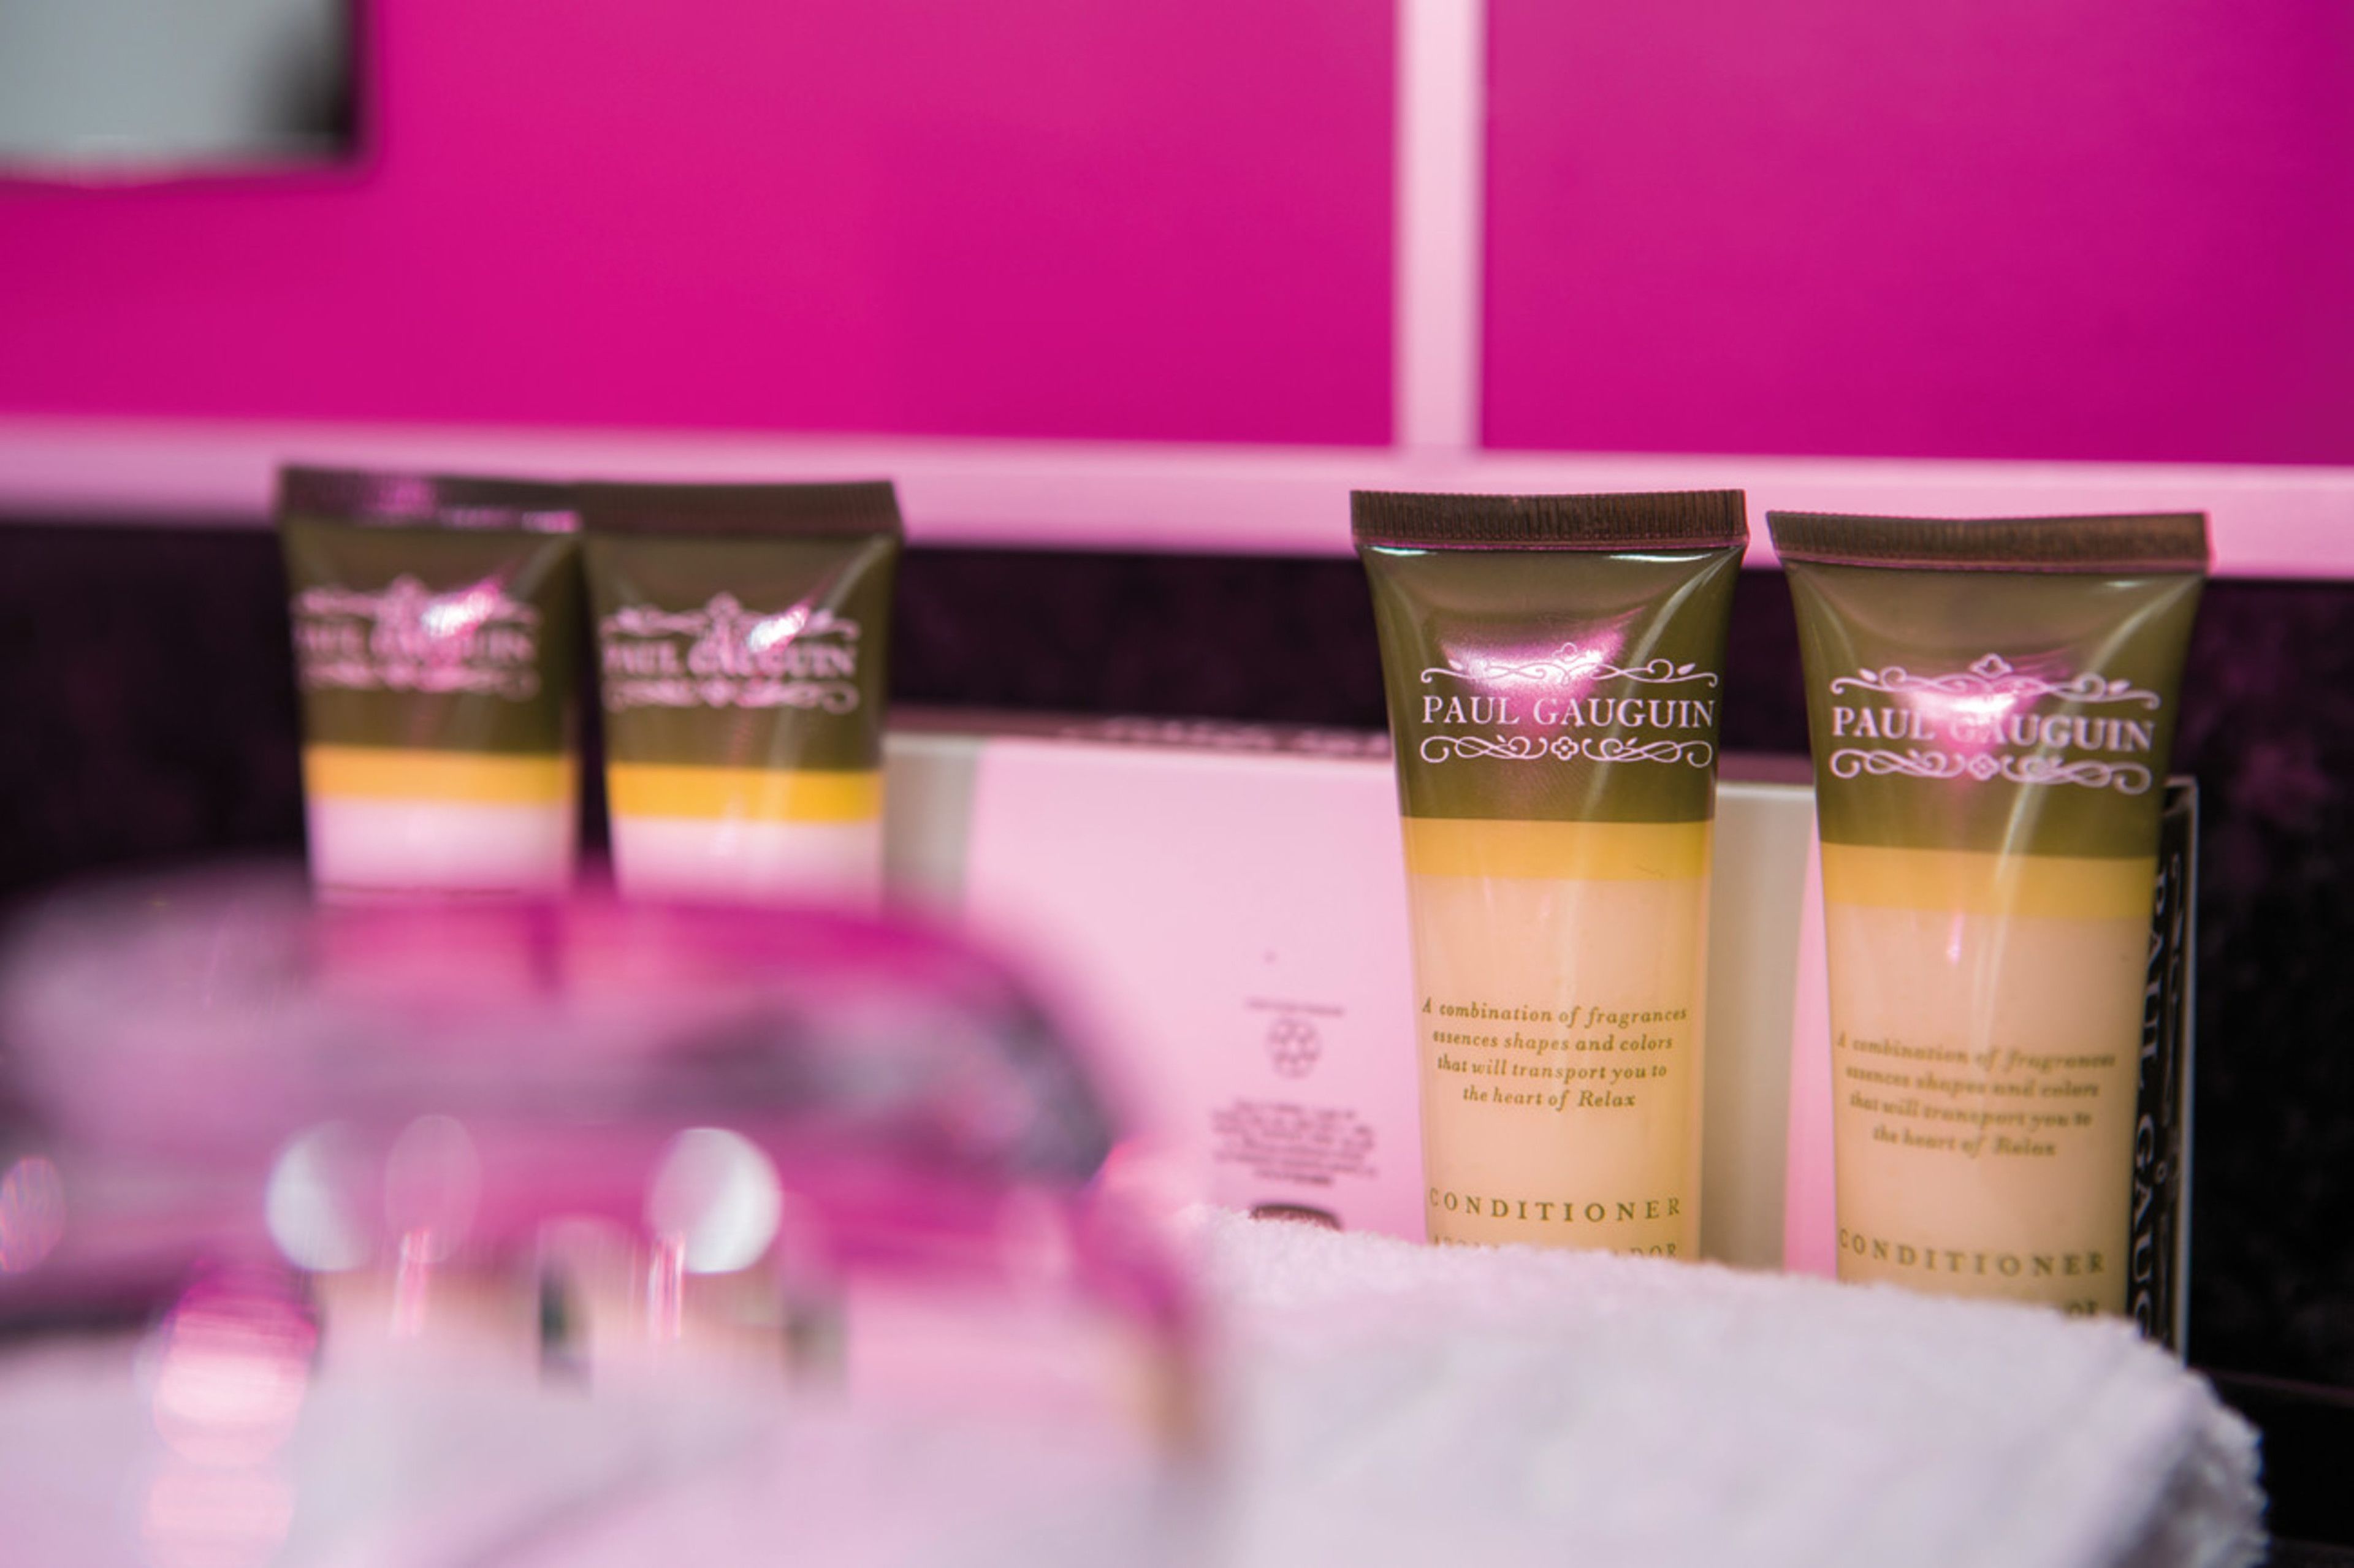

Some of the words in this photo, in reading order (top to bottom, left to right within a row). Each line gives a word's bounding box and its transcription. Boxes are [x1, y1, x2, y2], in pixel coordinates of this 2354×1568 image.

[1421, 695, 1520, 726] PAUL
[1533, 698, 1715, 729] GAUGUIN
[1830, 706, 1935, 741] PAUL
[1948, 712, 2155, 752] GAUGUIN
[1422, 997, 1432, 1014] A
[1439, 1000, 1553, 1022] combination
[1558, 1005, 1581, 1028] of
[1584, 1005, 1688, 1029] fragrances
[1432, 1030, 1498, 1048] essences
[1503, 1032, 1569, 1056] shapes
[1575, 1034, 1615, 1052] and
[1619, 1034, 1674, 1052] colors
[1851, 1036, 1968, 1065] combination
[1975, 1046, 2002, 1071] of
[2003, 1048, 2116, 1074] fragrances
[1437, 1053, 1468, 1073] that
[1472, 1059, 1507, 1076] will
[1512, 1062, 1606, 1085] transport
[1610, 1067, 1647, 1085] you
[1651, 1064, 1668, 1078] to
[1915, 1071, 1987, 1100] shapes
[1992, 1078, 2035, 1097] and
[2040, 1079, 2100, 1098] colors
[1463, 1084, 1488, 1103] the
[1493, 1086, 1543, 1106] heart
[1548, 1089, 1571, 1112] of
[1578, 1089, 1637, 1108] Relax
[1849, 1090, 1879, 1112] that
[1882, 1098, 1920, 1119] will
[1922, 1103, 2025, 1130] transport
[2030, 1111, 2069, 1131] you
[2073, 1111, 2092, 1127] to
[1872, 1123, 1899, 1144] the
[1902, 1128, 1957, 1151] heart
[1960, 1134, 1987, 1159] of
[1993, 1135, 2057, 1157] Relax
[1429, 1187, 1681, 1223] CONDITIONER
[1838, 1228, 2105, 1277] CONDITIONER
